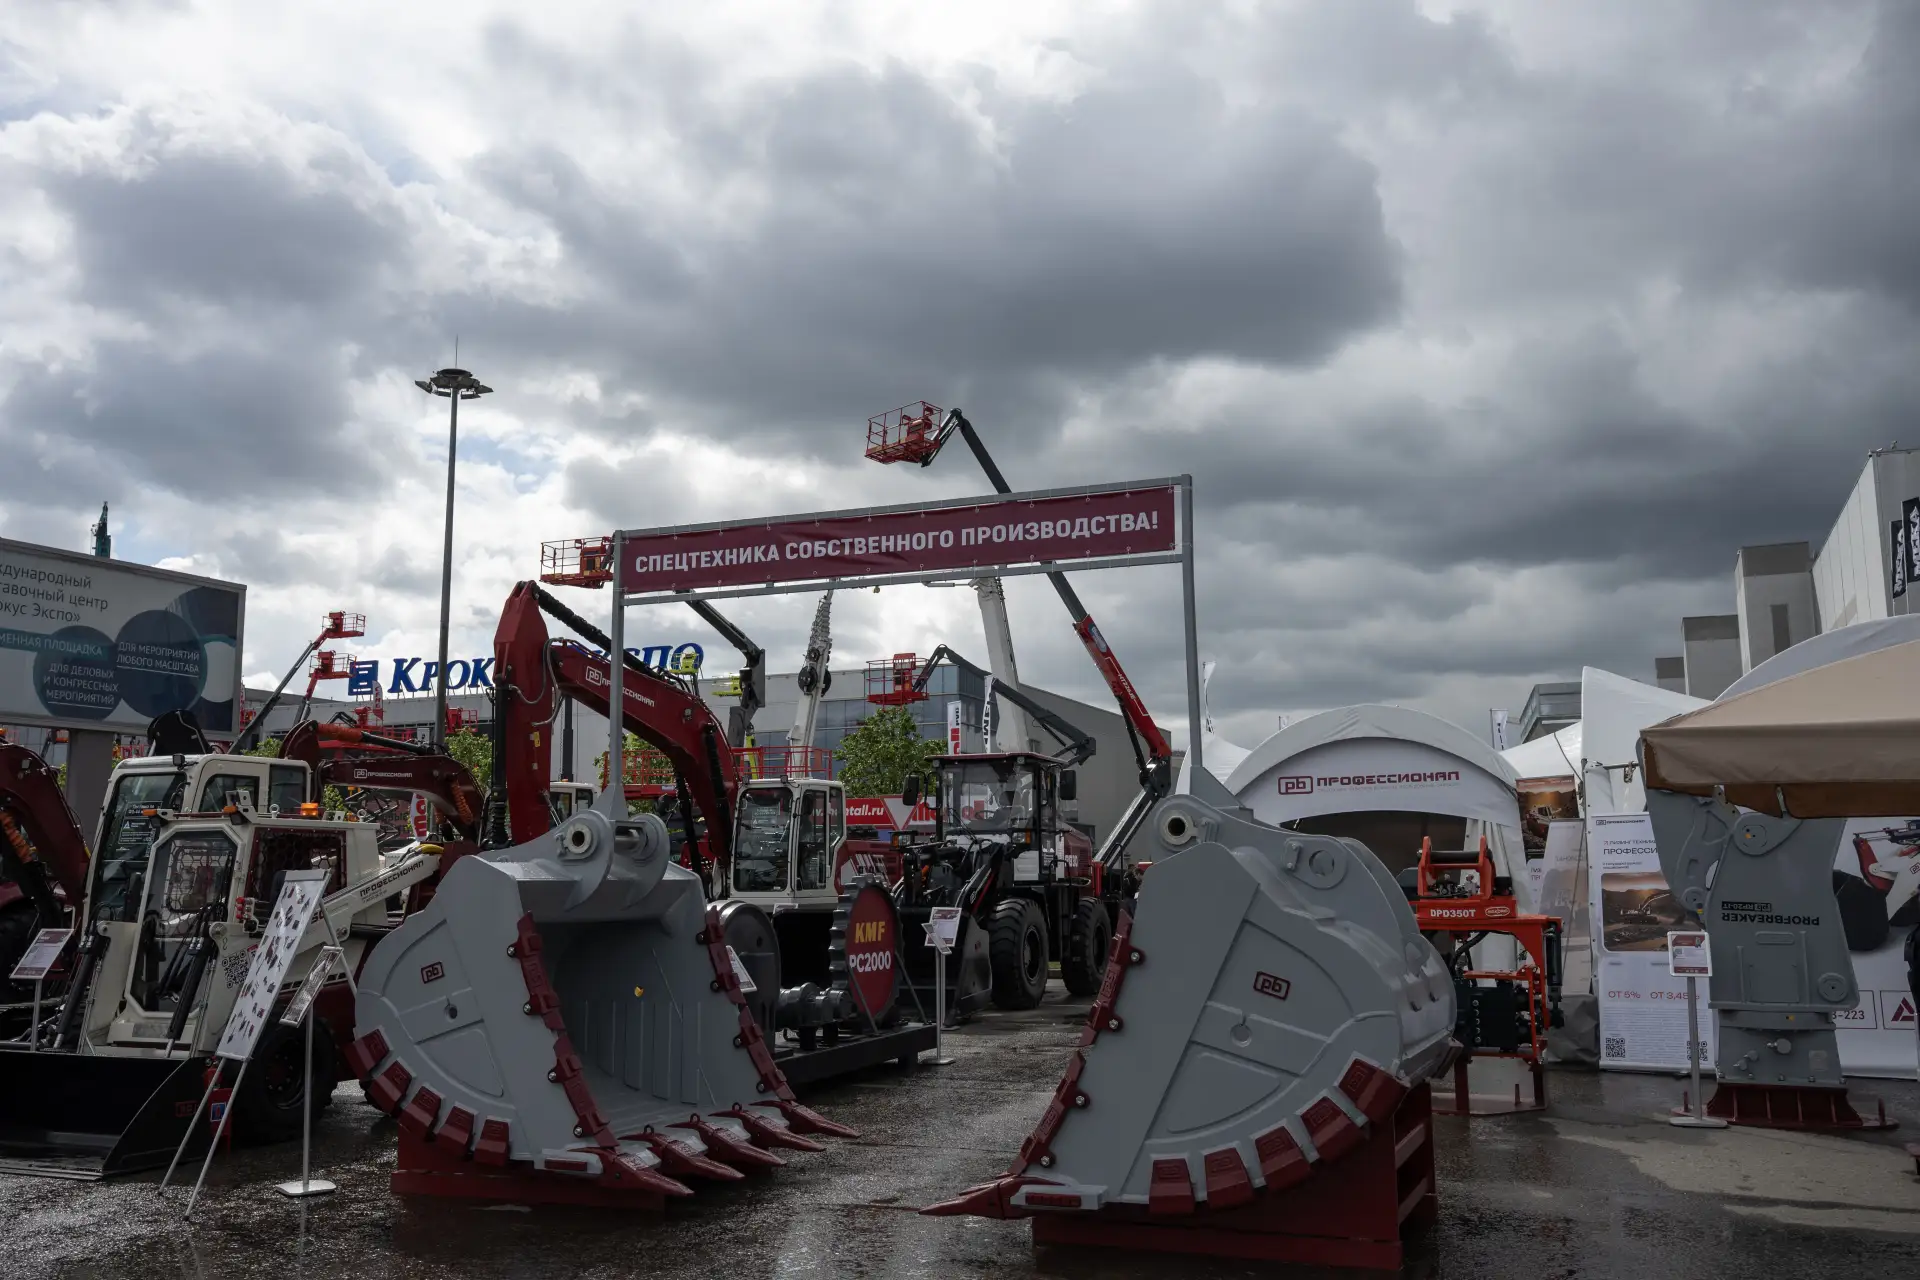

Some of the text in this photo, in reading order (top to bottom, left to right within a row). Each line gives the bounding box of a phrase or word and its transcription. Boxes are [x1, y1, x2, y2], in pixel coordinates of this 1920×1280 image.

[635, 510, 1158, 573] СПЕЦТЕХНИКА СОБСТВЕННОГО ПРОИЗВОДСТВА!
[69, 595, 109, 612] центр
[31, 603, 81, 623] Экспо»
[43, 637, 103, 656] ПЛОЩАДКА
[118, 641, 200, 661] ДЛЯ МЕРОПРИЯТИЙ
[50, 662, 115, 679] ДЛЯ ДЕЛОВЫХ
[116, 654, 200, 673] ЛЮБОГО МАСШТАБА
[43, 676, 119, 692] И КОНГРЕССНЫХ
[46, 689, 115, 705] МЕРОПРИЯТИЙ
[1317, 771, 1460, 787] ПРОФЕССИОНАЛ
[360, 861, 424, 897] ПРОФЕССИОНАЛ
[1430, 908, 1476, 918] DPD350T
[1722, 912, 1820, 926] PROFBREAKER
[855, 921, 886, 944] KMF
[849, 950, 892, 973] PC2000
[1624, 991, 1641, 999] 5%
[1650, 991, 1666, 999] ОТ
